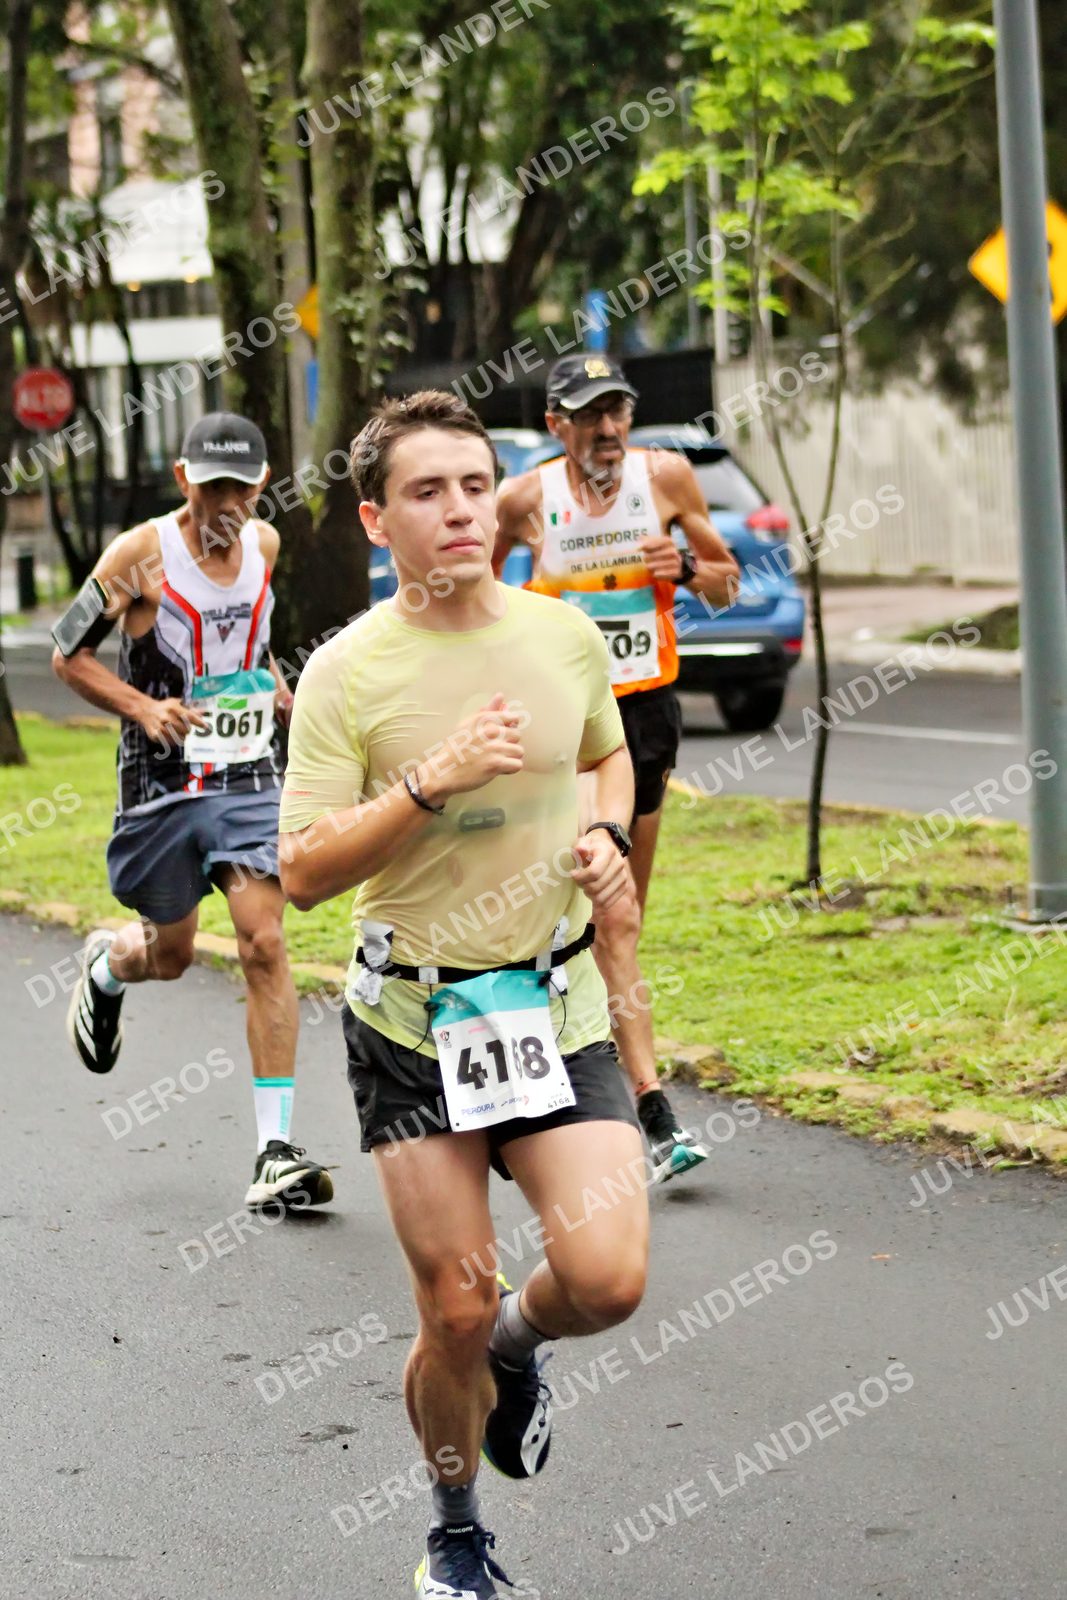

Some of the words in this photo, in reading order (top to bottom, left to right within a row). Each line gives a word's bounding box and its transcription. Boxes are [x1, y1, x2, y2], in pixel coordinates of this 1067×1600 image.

[560, 528, 648, 552] CORREDORES
[571, 564, 583, 574] DE
[585, 562, 598, 571] LA
[600, 554, 642, 569] LLANURA
